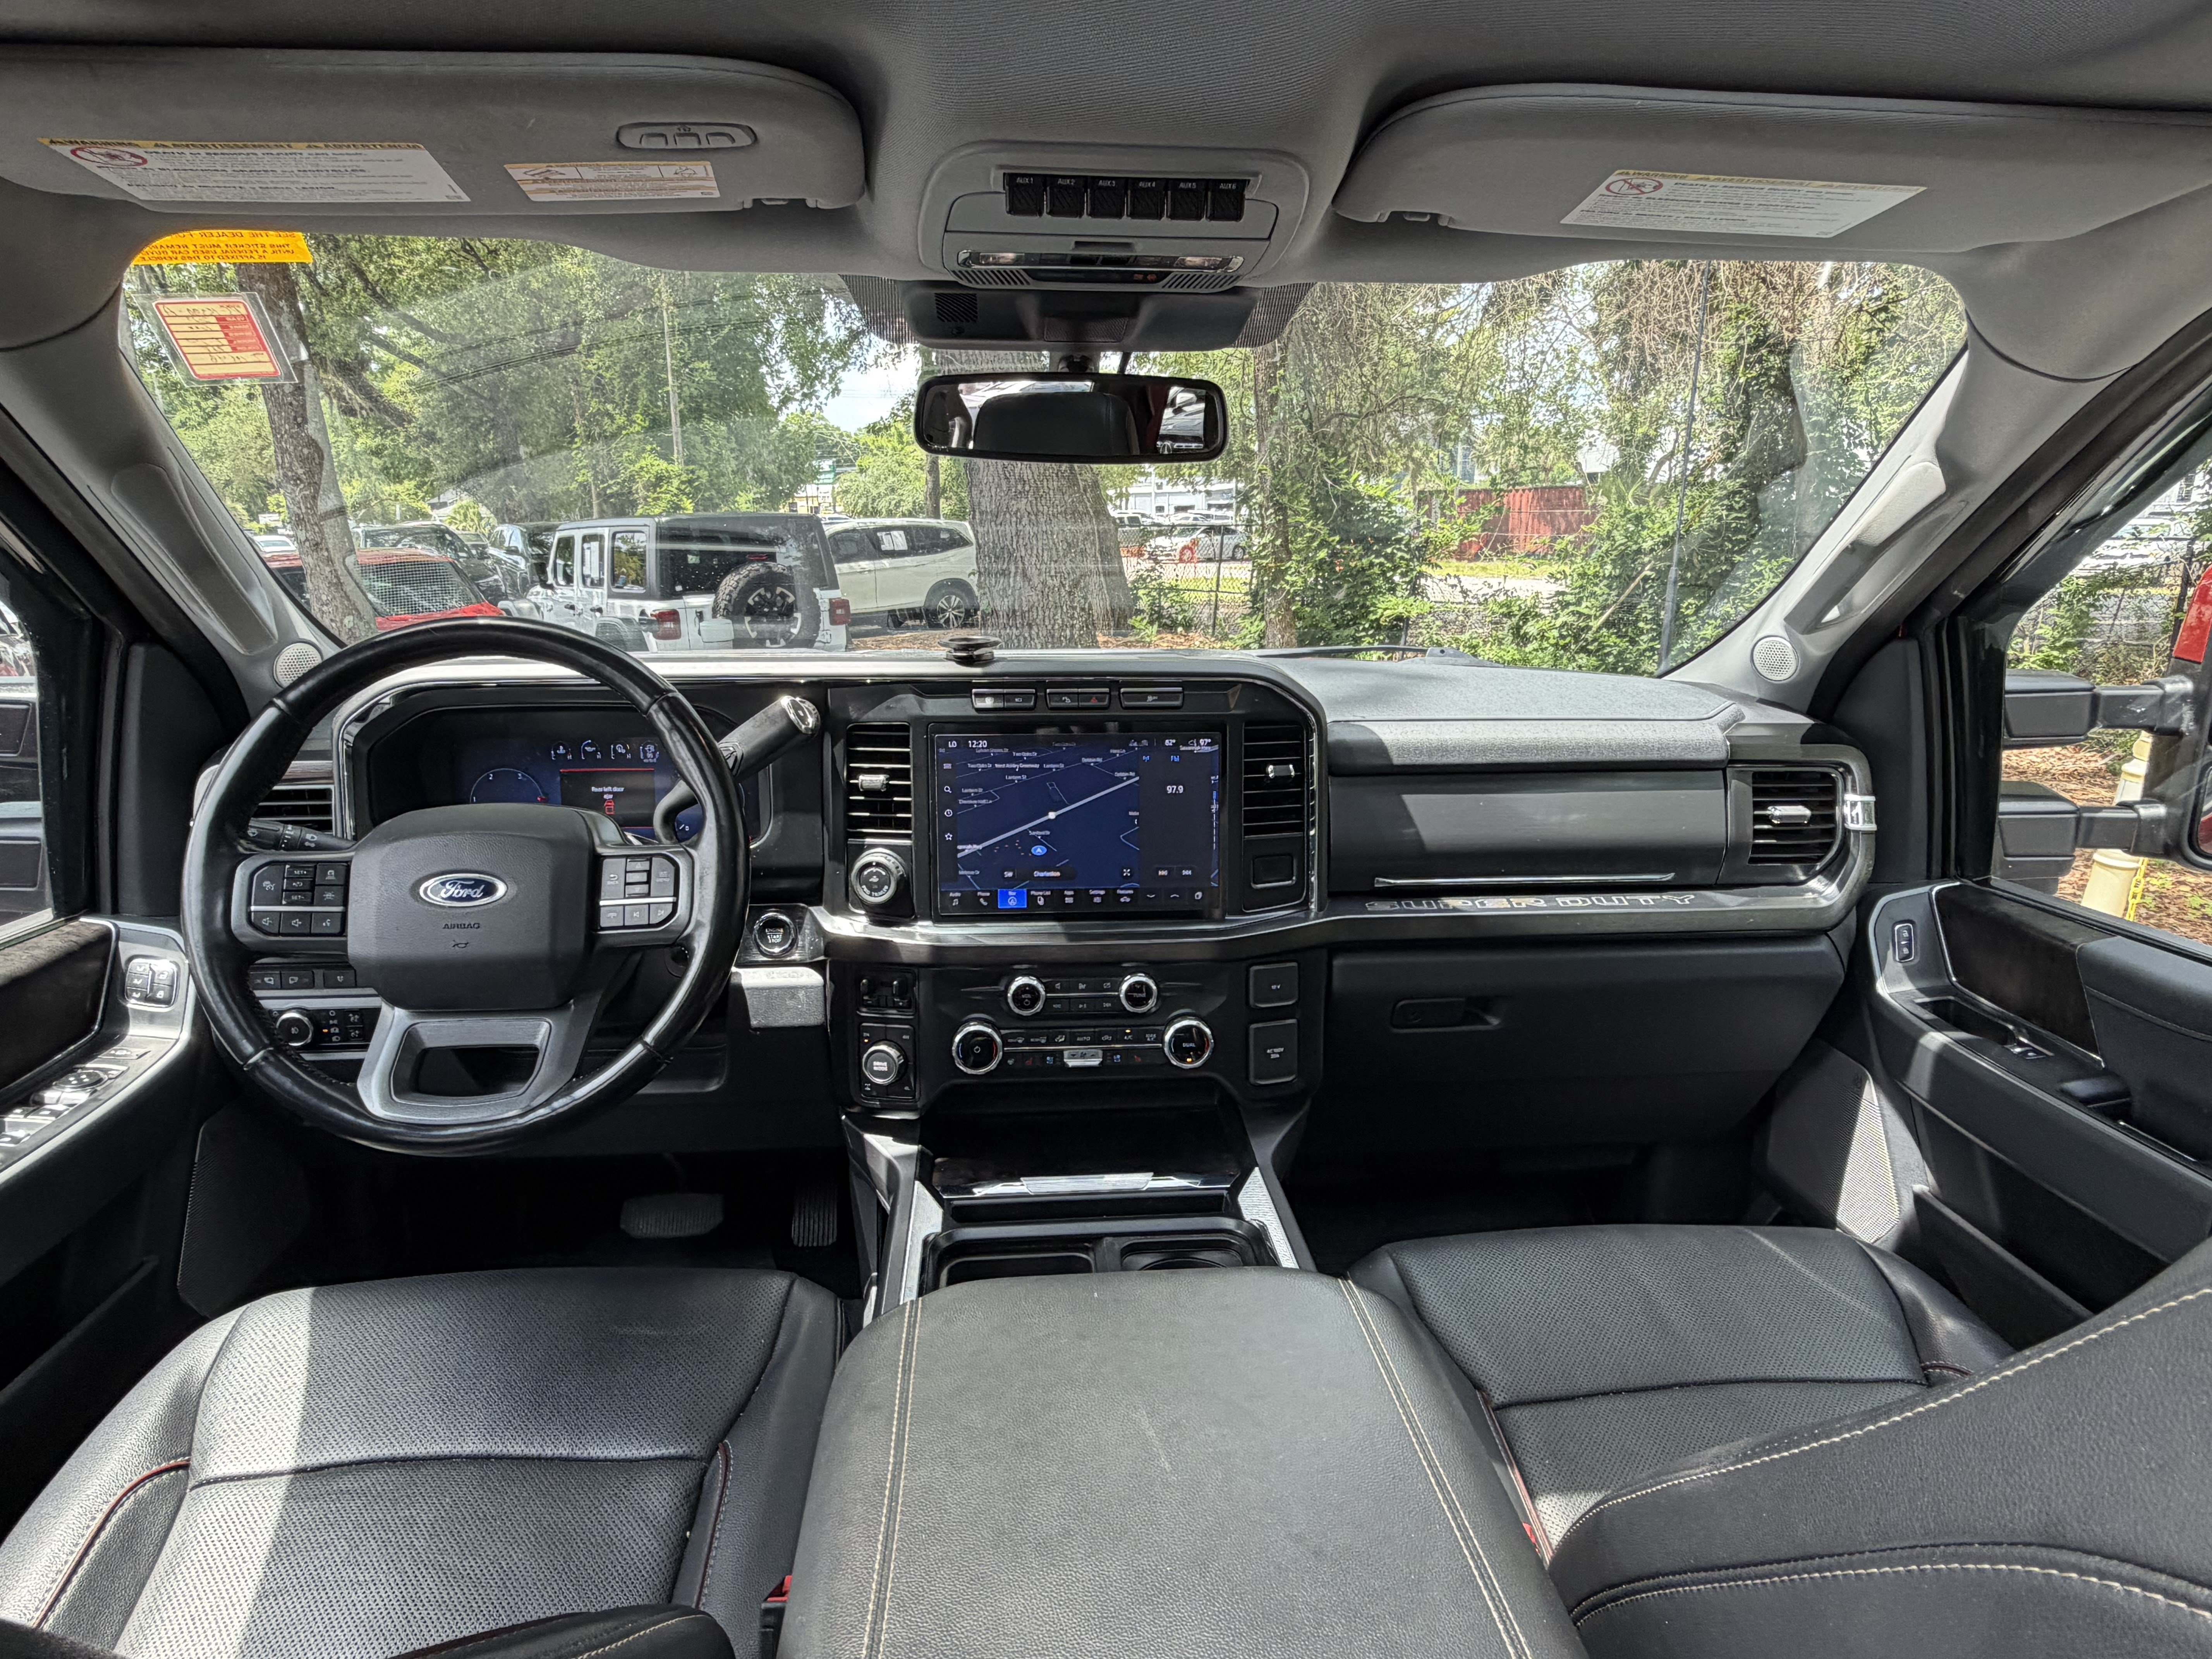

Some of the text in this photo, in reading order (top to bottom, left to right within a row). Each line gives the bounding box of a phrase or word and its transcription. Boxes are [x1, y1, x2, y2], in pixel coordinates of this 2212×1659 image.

[1166, 785, 1184, 794] 97.9
[440, 880, 486, 898] Ford
[1365, 894, 1695, 911] SUPER DUTY
